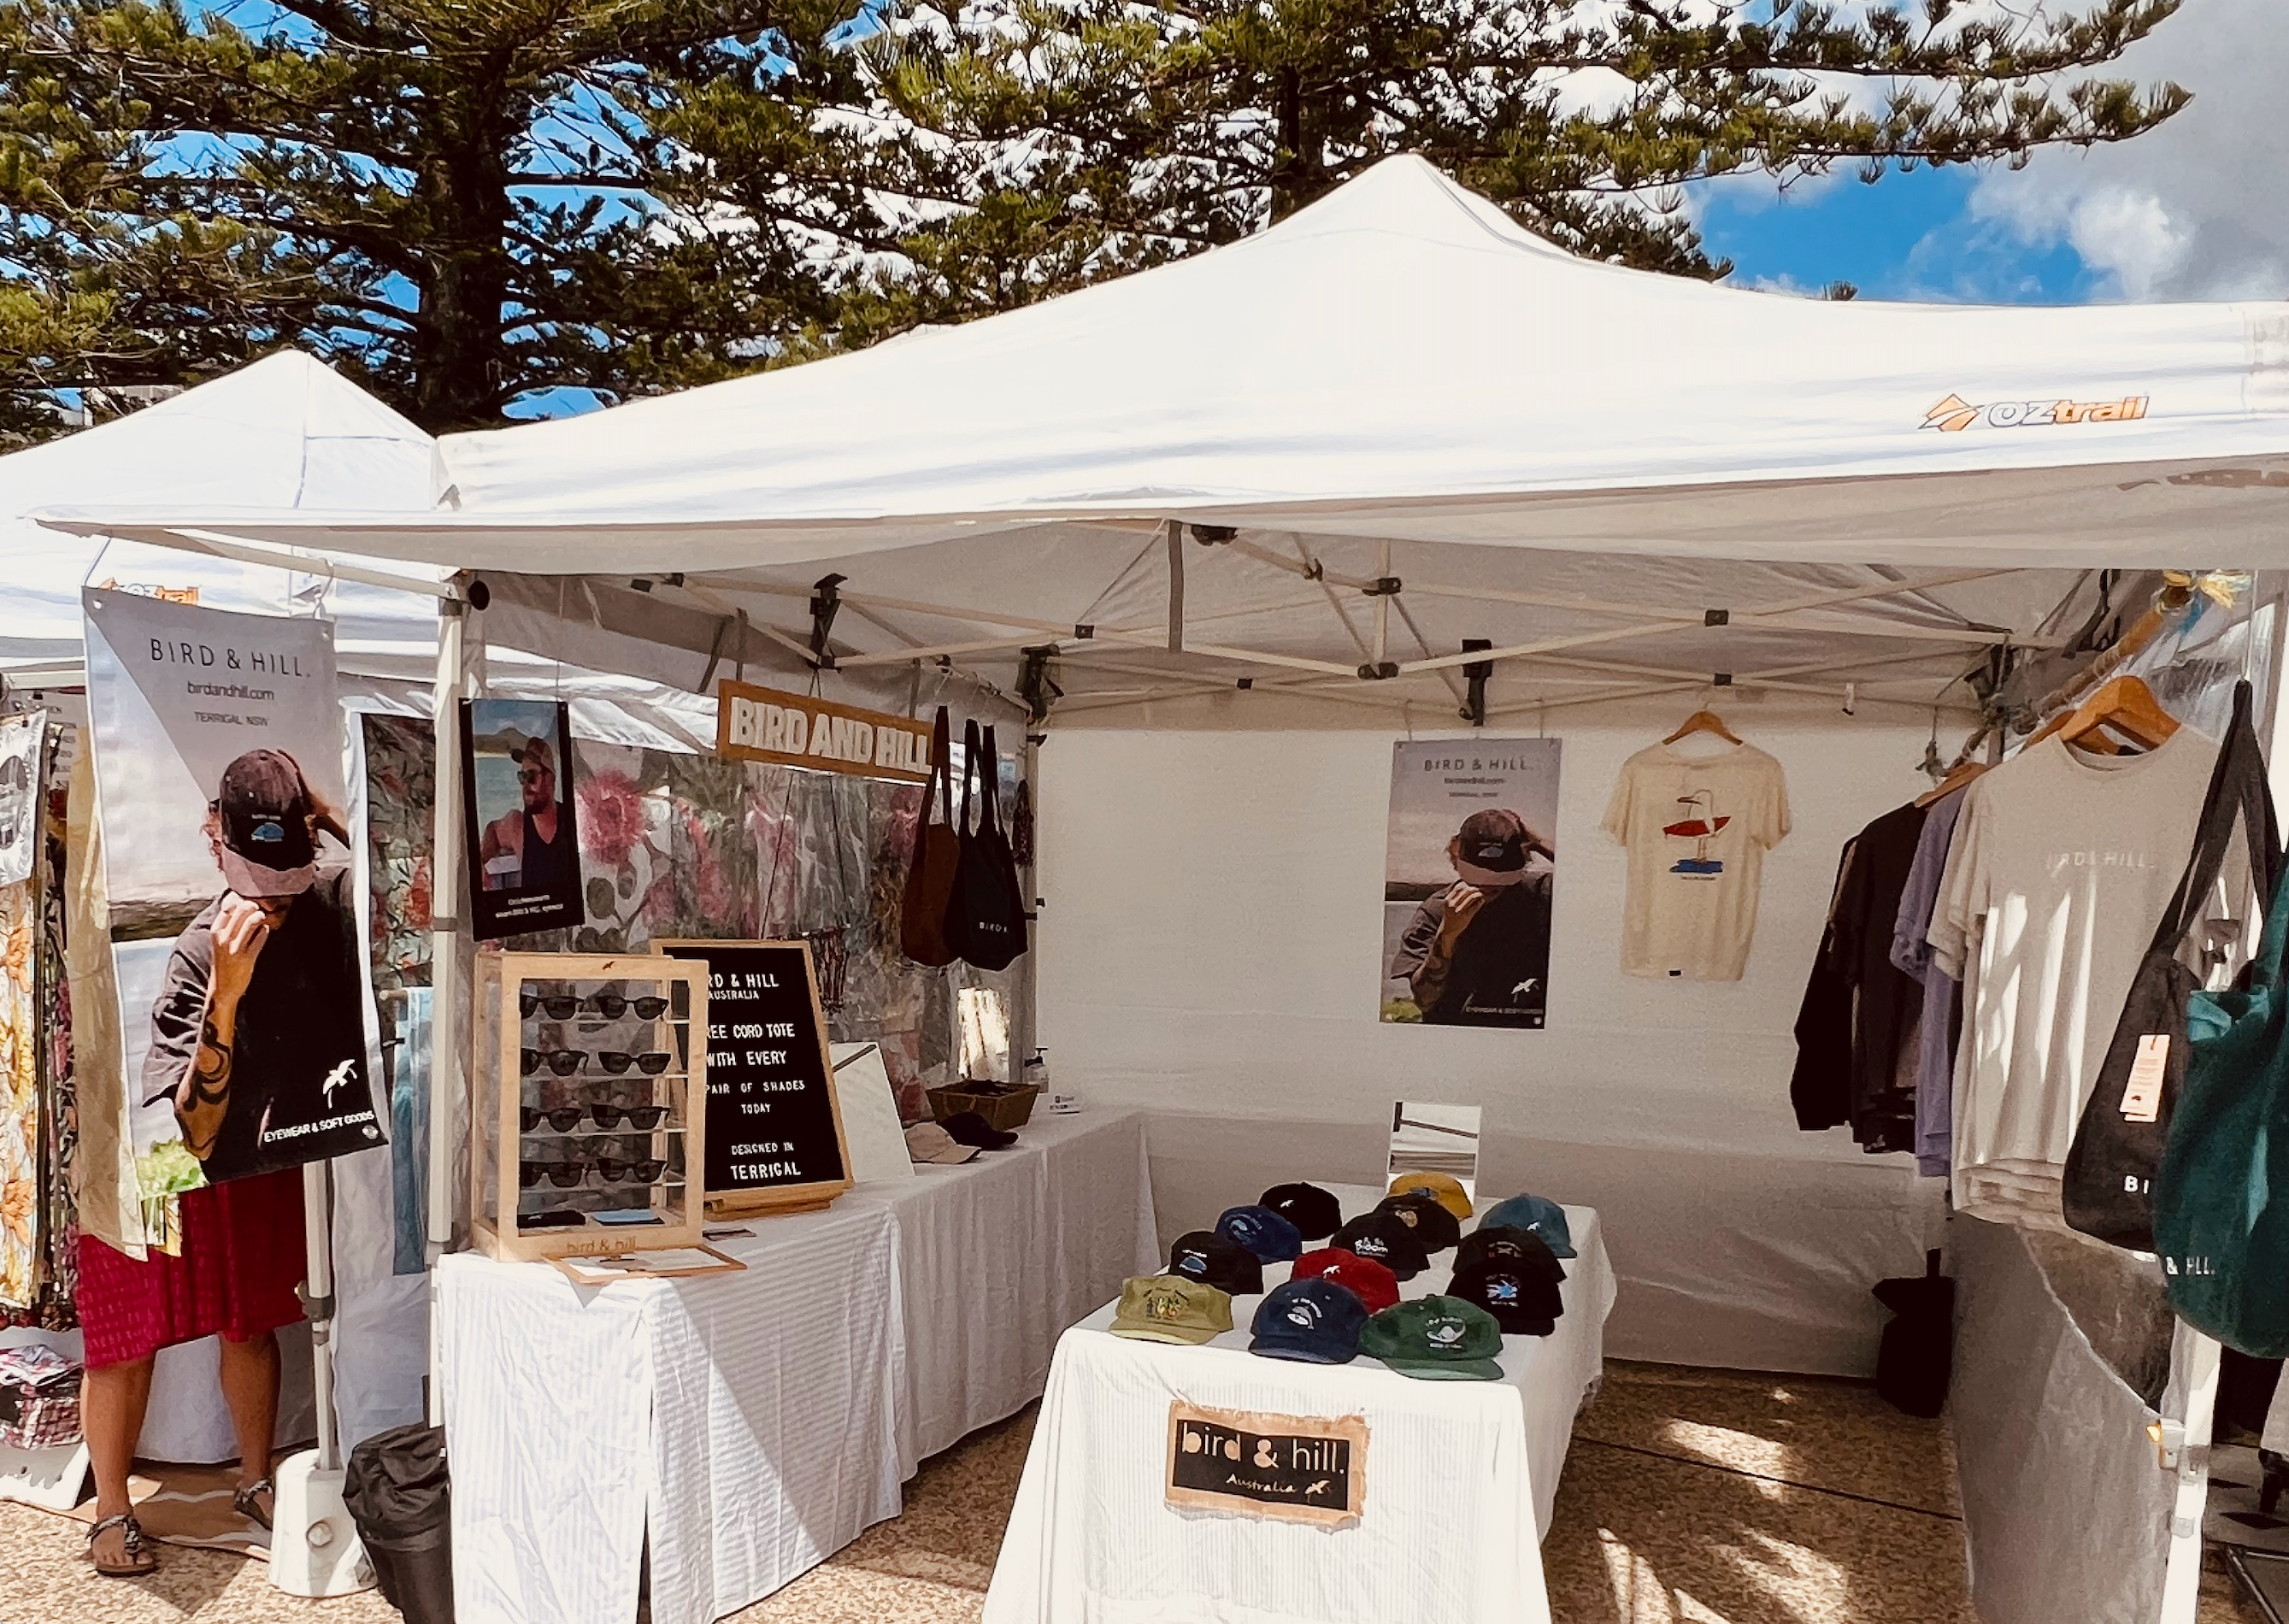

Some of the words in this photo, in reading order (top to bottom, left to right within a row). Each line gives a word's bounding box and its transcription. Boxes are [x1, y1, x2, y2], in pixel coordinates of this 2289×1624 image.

[1986, 395, 2150, 427] OZtrail
[150, 638, 214, 667] BIRD
[227, 648, 241, 670] &
[730, 697, 809, 755] BIRD
[809, 713, 874, 764] AND
[875, 726, 933, 775] HILL
[1424, 759, 1464, 771] BIRD
[1472, 758, 1482, 770] &
[709, 973, 724, 988] RD
[731, 973, 740, 987] &
[745, 973, 780, 988] HILL
[708, 990, 760, 1000] AUSTRALIA
[707, 1024, 728, 1039] REE
[733, 1024, 763, 1039] CORD
[765, 1023, 796, 1038] TOTE
[707, 1051, 737, 1067] WITH
[746, 1050, 786, 1065] EVERY
[705, 1082, 730, 1094] PAIR
[740, 1082, 752, 1093] OF
[762, 1080, 805, 1091] SHADES
[740, 1103, 771, 1114] TODAY
[264, 1124, 311, 1143] EYEWEAR
[311, 1122, 319, 1133] &
[319, 1116, 344, 1131] SOFT
[344, 1110, 375, 1125] GOODS
[731, 1142, 778, 1155] DESIGNED
[783, 1141, 794, 1151] IN
[730, 1162, 802, 1180] TERRIGAL
[599, 1238, 610, 1251] &
[1181, 1422, 1242, 1462] bird
[1253, 1439, 1280, 1469] &
[1292, 1438, 1345, 1474] hill.
[1225, 1473, 1297, 1493] Australia
